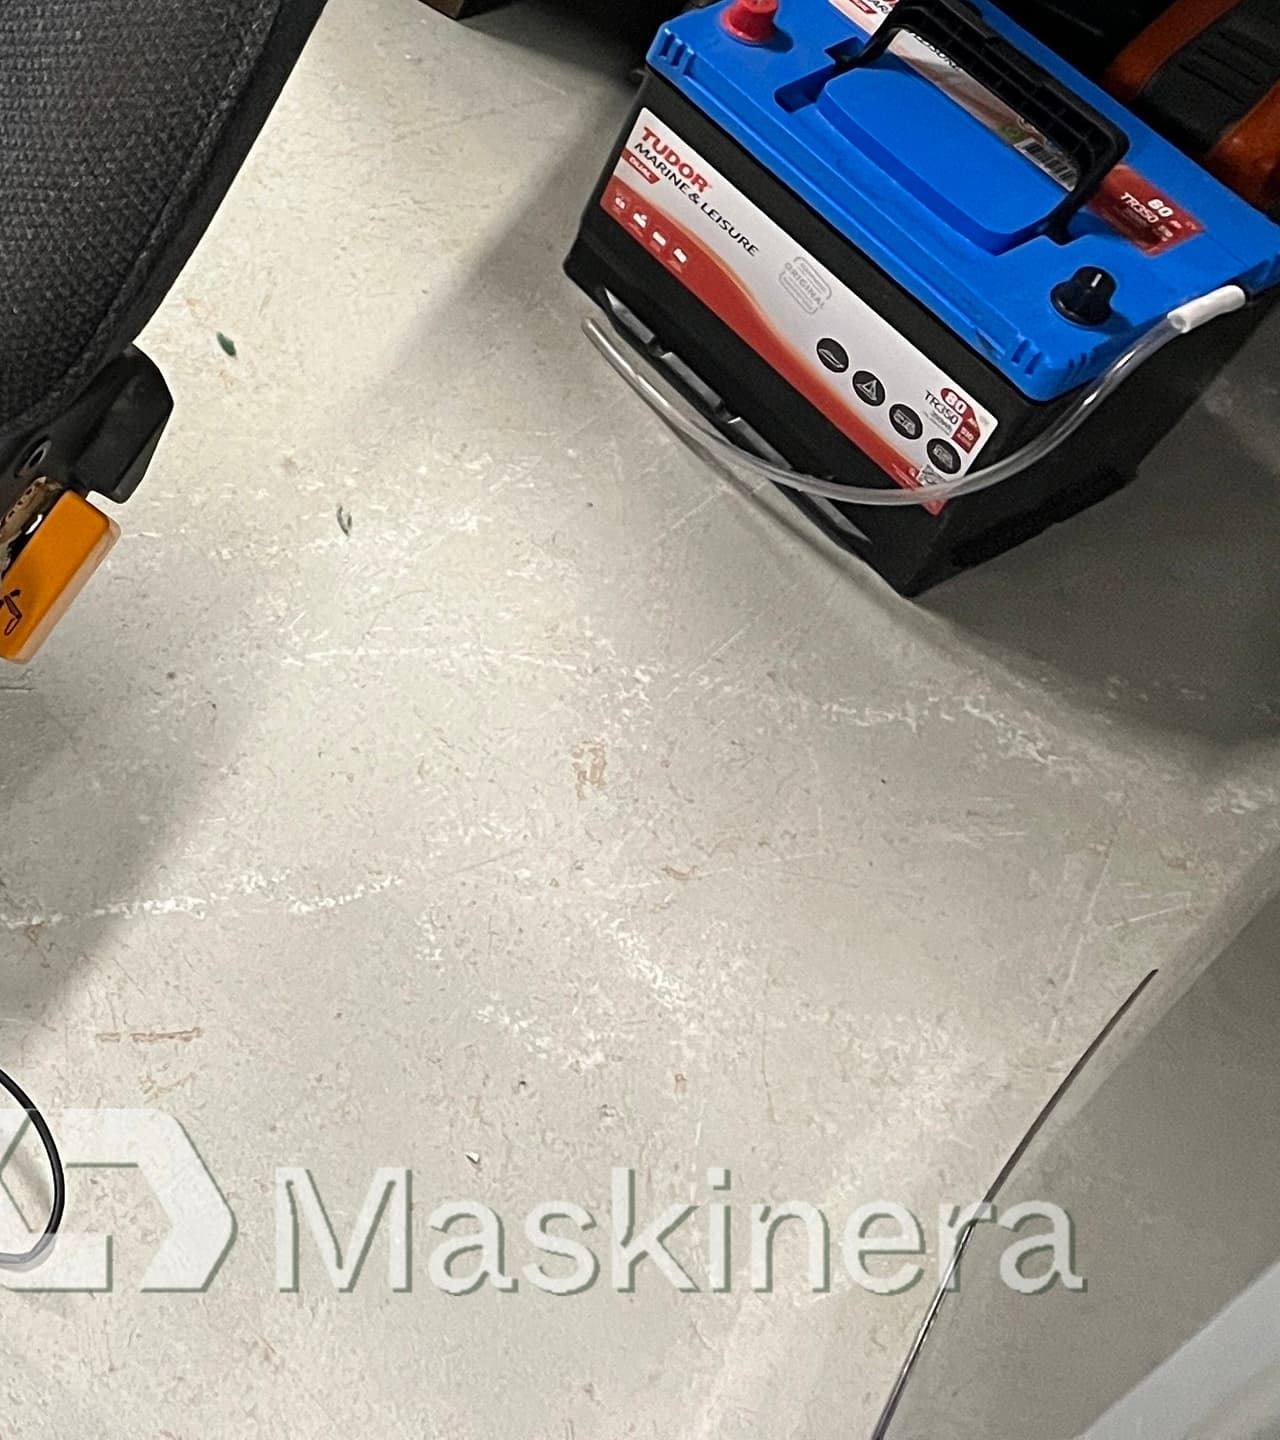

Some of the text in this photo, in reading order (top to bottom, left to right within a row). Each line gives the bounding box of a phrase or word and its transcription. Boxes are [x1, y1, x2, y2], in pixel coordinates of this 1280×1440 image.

[642, 127, 710, 193] TUDOR
[634, 143, 690, 195] MARINE
[688, 192, 701, 204] &
[700, 202, 759, 257] LEISURE
[1120, 191, 1159, 223] TR350
[1147, 198, 1174, 217] 80
[784, 262, 825, 310] ORIGINAL
[925, 390, 959, 424] TR350
[944, 391, 967, 415] 80
